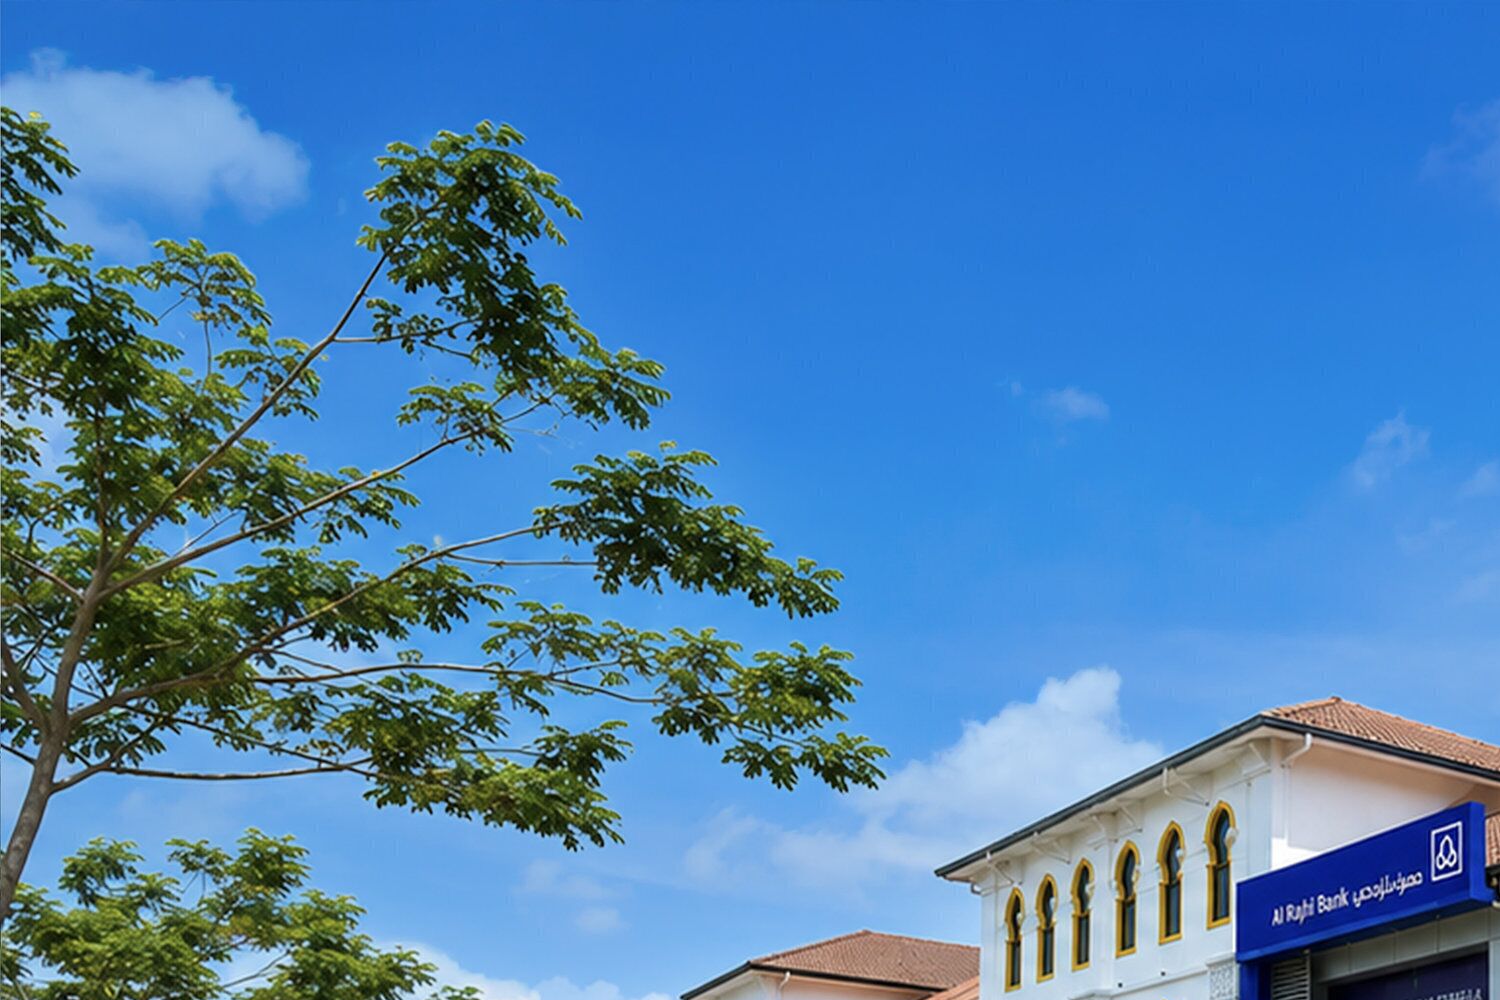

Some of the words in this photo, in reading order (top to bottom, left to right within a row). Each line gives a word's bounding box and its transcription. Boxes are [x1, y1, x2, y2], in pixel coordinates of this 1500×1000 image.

[1272, 906, 1283, 926] Al
[1285, 897, 1315, 924] Rajhi
[1317, 886, 1350, 914] Bank
